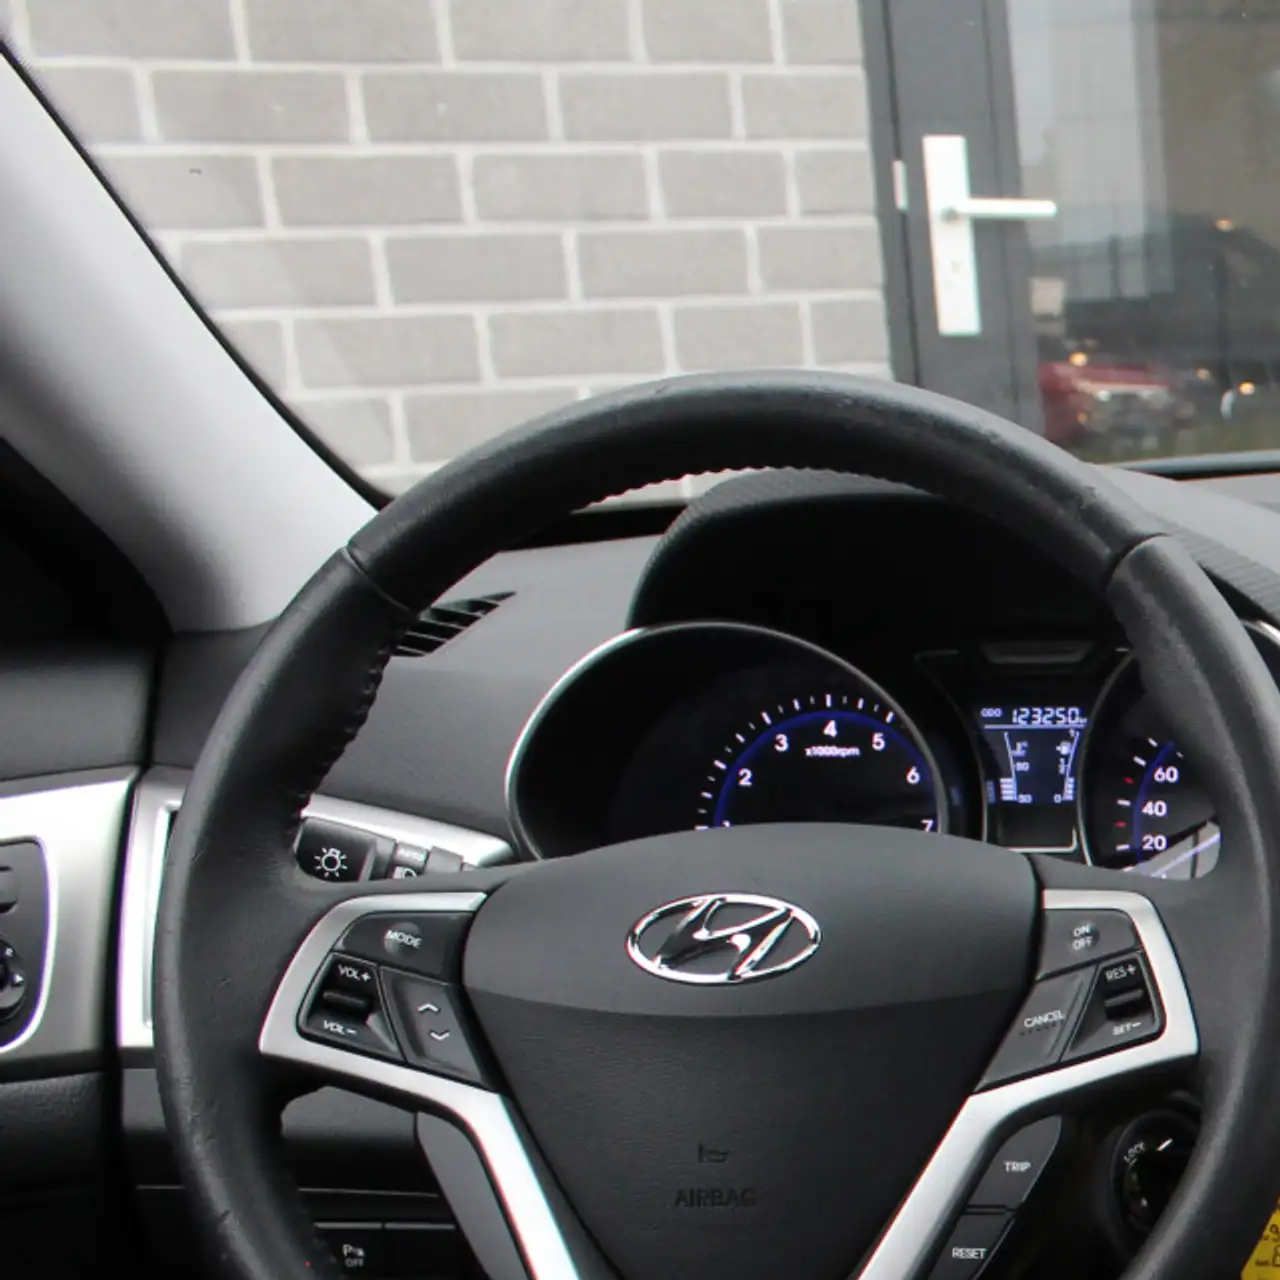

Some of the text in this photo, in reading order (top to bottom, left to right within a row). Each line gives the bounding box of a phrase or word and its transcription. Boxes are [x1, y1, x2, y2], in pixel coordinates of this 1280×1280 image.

[1012, 707, 1080, 724] 123250
[823, 720, 838, 737] 4
[774, 733, 789, 752] 3
[872, 732, 886, 750] 5
[738, 768, 752, 786] 2
[906, 766, 921, 784] 6
[1154, 767, 1178, 782] 60
[1142, 801, 1167, 816] 40
[1142, 835, 1167, 850] 20
[1073, 924, 1091, 937] ON
[385, 930, 423, 949] MODE
[1072, 936, 1093, 951] OFF
[1024, 1010, 1064, 1028] CANCEL
[1004, 1161, 1031, 1172] TRIP
[675, 1188, 757, 1208] AIRBAG
[952, 1248, 987, 1259] RESET
